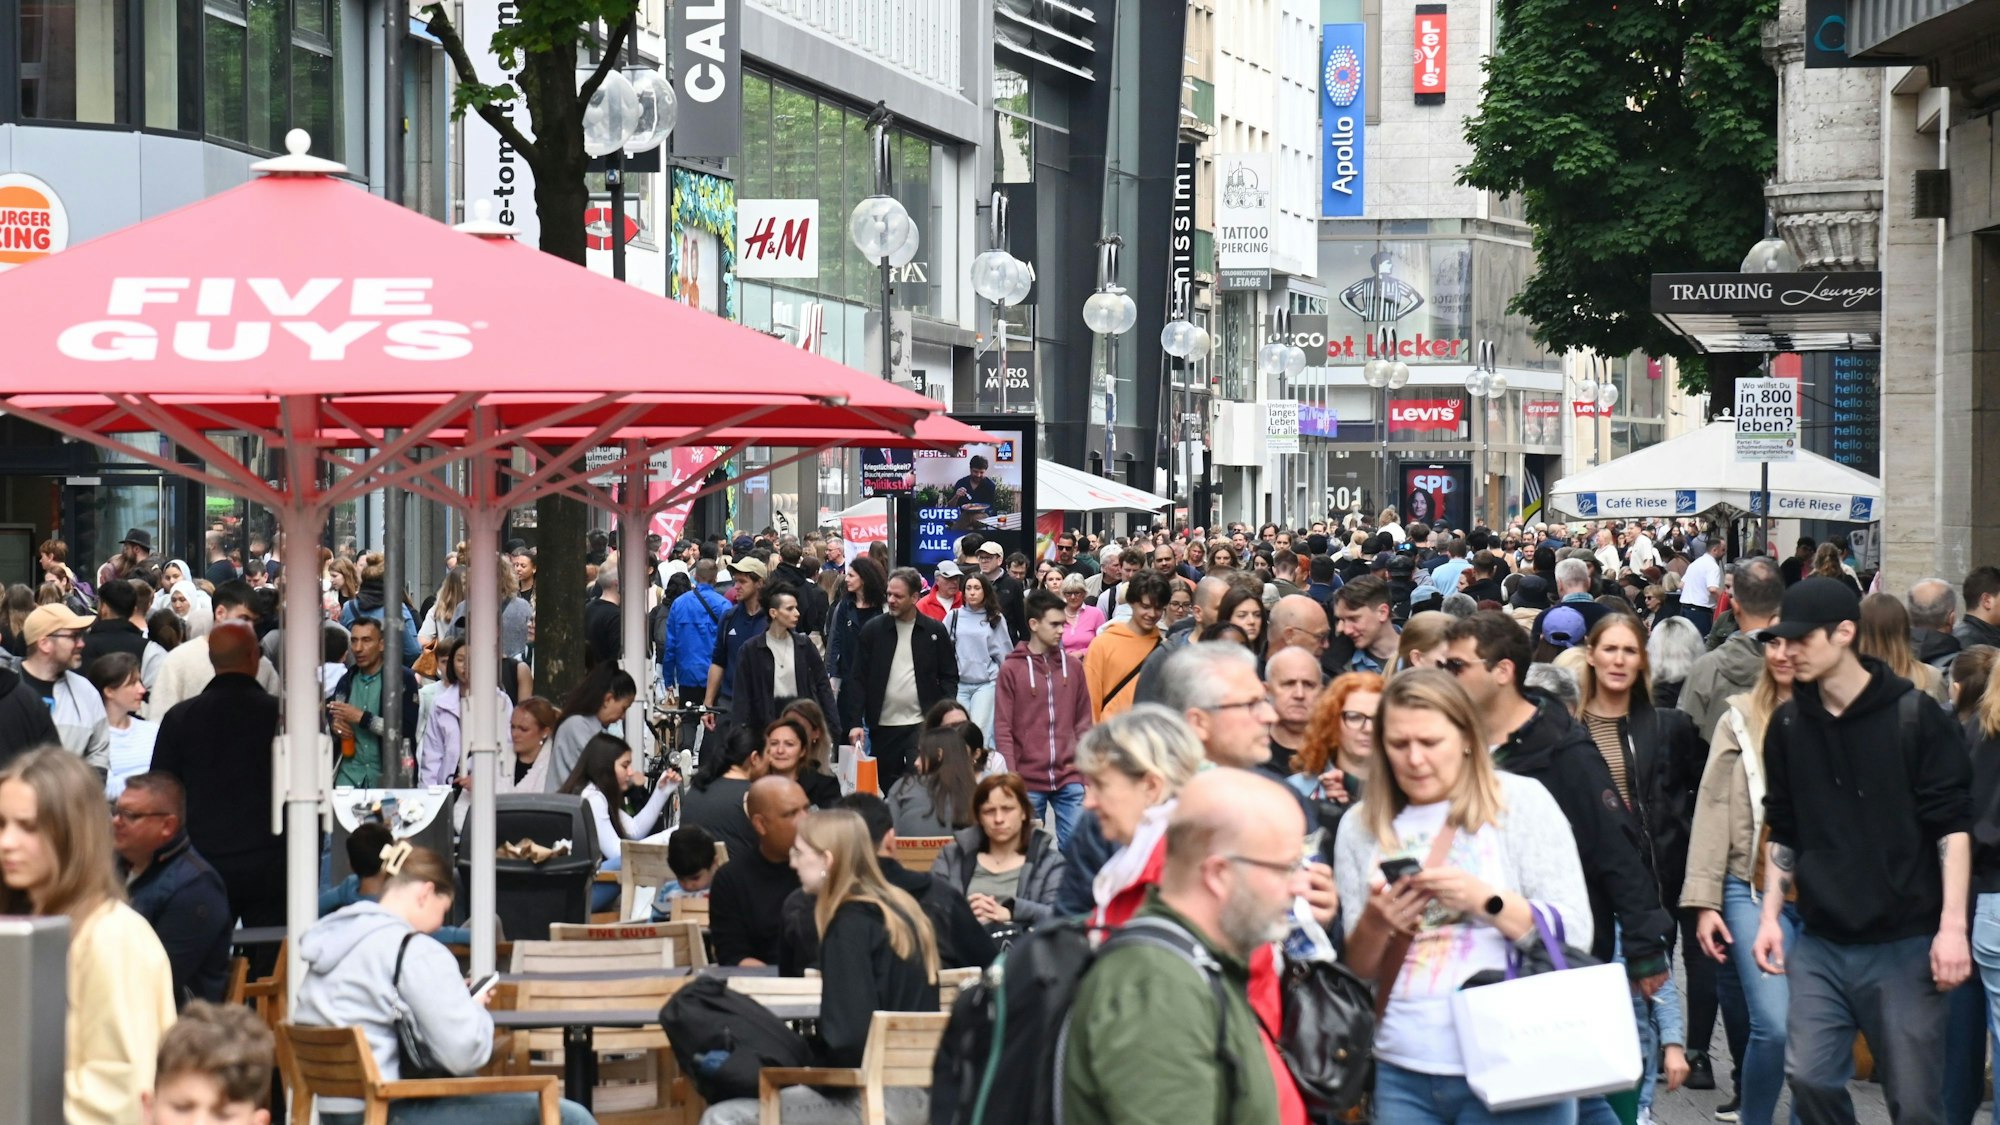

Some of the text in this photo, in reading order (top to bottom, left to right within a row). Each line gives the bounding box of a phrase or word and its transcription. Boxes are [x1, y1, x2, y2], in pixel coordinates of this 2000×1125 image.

[1331, 116, 1358, 195] Apollo
[0, 226, 51, 250] ING
[744, 216, 810, 261] H&M
[1221, 226, 1268, 240] TATTOO
[1221, 242, 1268, 253] PIERCING
[1229, 277, 1261, 288] 1.ETAGE
[107, 277, 434, 316] FIVE
[1669, 275, 1881, 308] TRAURING Lounge
[57, 320, 474, 361] GUYS
[1835, 356, 1863, 367] hello
[987, 367, 1027, 378] VRO
[1835, 370, 1863, 380] hello
[984, 378, 1029, 389] MDA
[1834, 384, 1863, 394] hello
[1740, 390, 1792, 403] in 800
[1834, 398, 1863, 408] hello
[1269, 408, 1297, 418] langes
[1391, 407, 1455, 421] Levi's
[1737, 403, 1793, 417] Jahren
[1270, 417, 1296, 426] Leben
[1834, 412, 1862, 422] hello
[1267, 426, 1298, 435] für alle
[1737, 418, 1793, 432] leben?
[1834, 426, 1862, 436] hello
[1834, 439, 1862, 449] hello
[1413, 475, 1457, 494] SPD
[1606, 497, 1632, 509] Café
[1635, 497, 1667, 508] Riese
[1778, 497, 1806, 509] Café
[1809, 499, 1842, 511] Riese
[919, 509, 958, 520] GUTES
[919, 523, 944, 536] FÜR
[919, 539, 951, 550] ALLE.
[587, 926, 657, 938] FIVE GUYS
